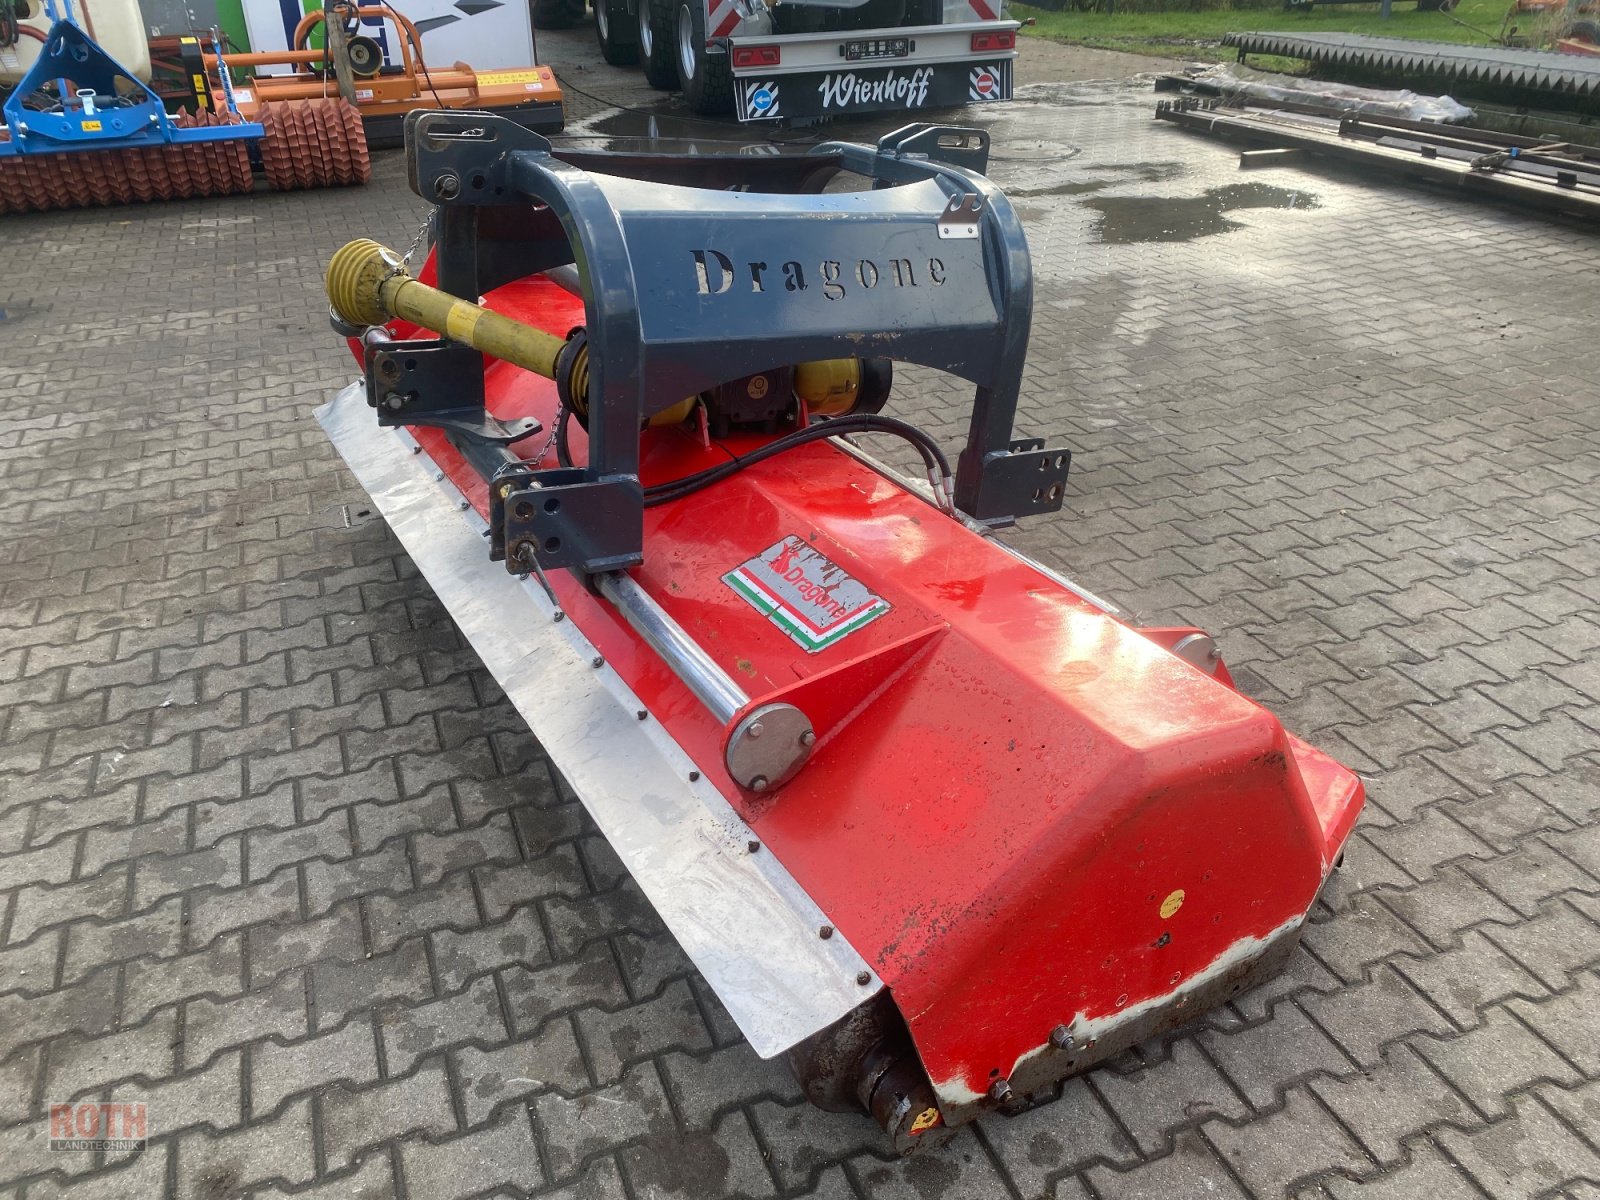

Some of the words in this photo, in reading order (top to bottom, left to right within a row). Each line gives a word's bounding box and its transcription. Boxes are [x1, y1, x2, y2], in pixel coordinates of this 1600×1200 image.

[817, 66, 934, 108] Wienhoff
[689, 249, 947, 301] Dragone
[783, 566, 847, 618] Dragone
